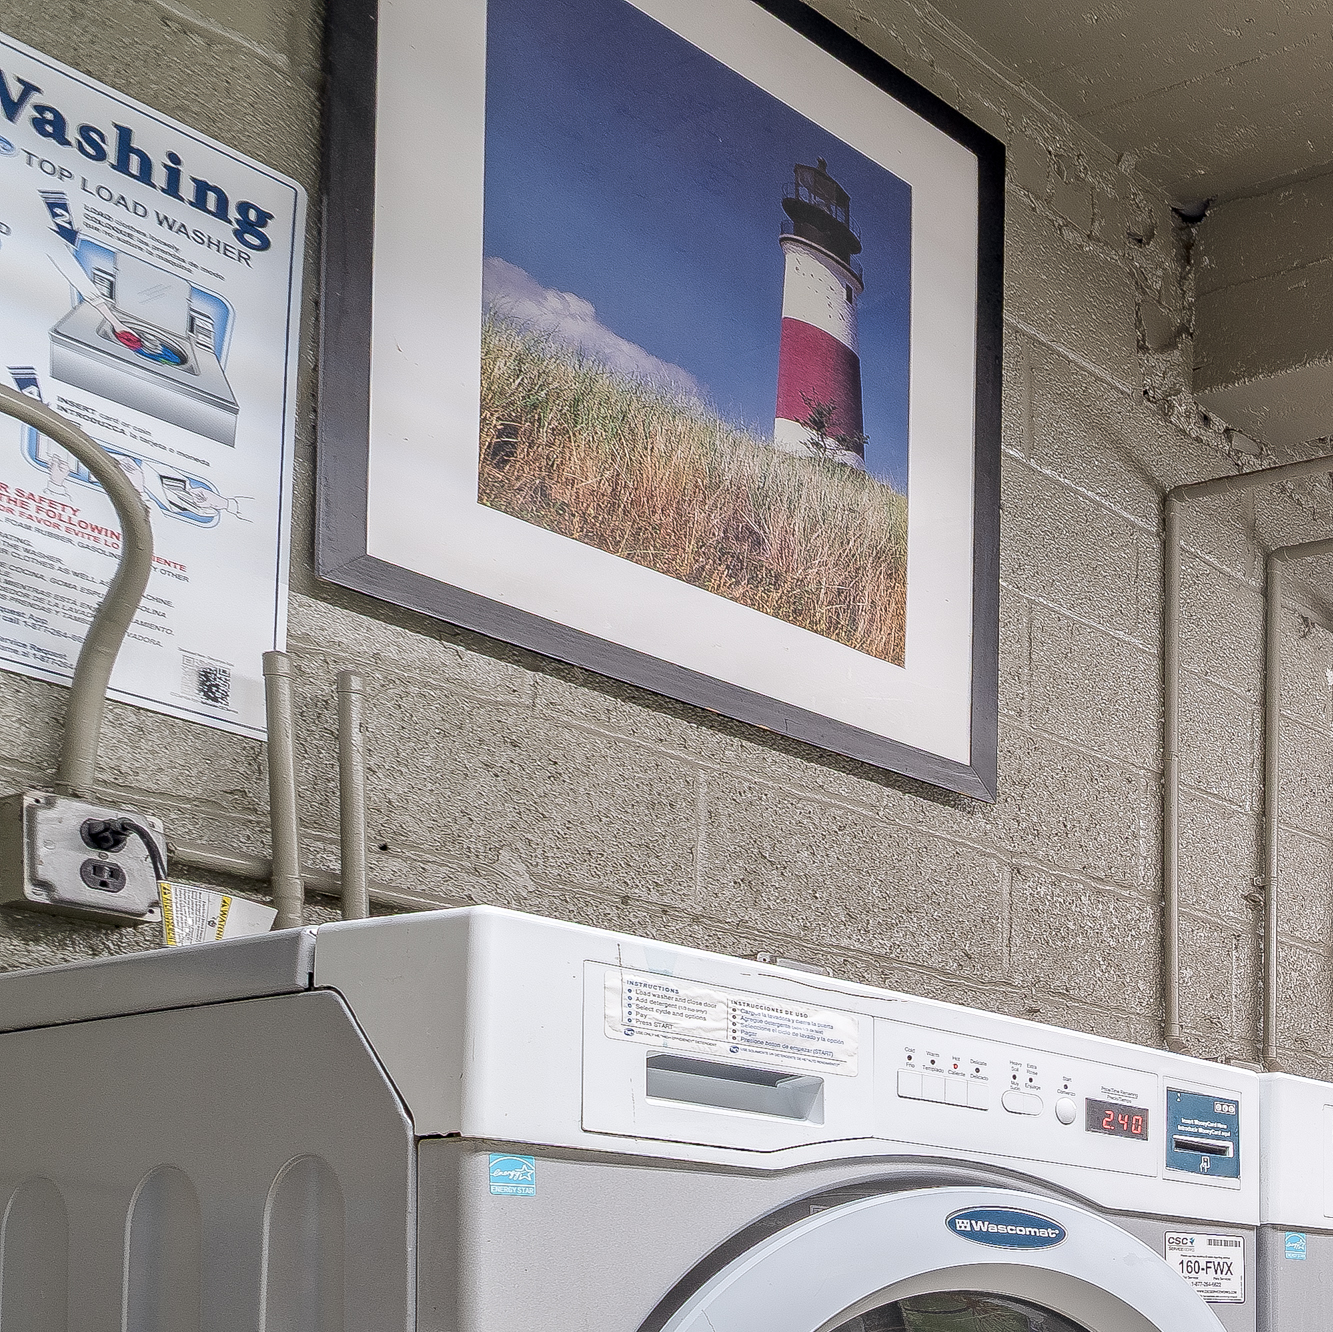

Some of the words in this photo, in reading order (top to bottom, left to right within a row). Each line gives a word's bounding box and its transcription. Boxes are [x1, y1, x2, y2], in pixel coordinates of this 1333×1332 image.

[22, 148, 74, 181] TOP
[80, 177, 148, 219] LOAD
[155, 210, 253, 268] WASHER
[14, 487, 81, 517] SAFETY
[19, 510, 61, 531] FAVOR
[35, 504, 121, 541] FOLLOWIN
[626, 979, 679, 994] INSTRUCTIONS
[635, 1011, 647, 1019] Pay
[653, 1021, 673, 1030] START
[1102, 1110, 1143, 1134] 2.40
[971, 1220, 1058, 1238] Wascomat
[1168, 1237, 1188, 1245] CSC
[1179, 1260, 1233, 1275] 160-FWX
